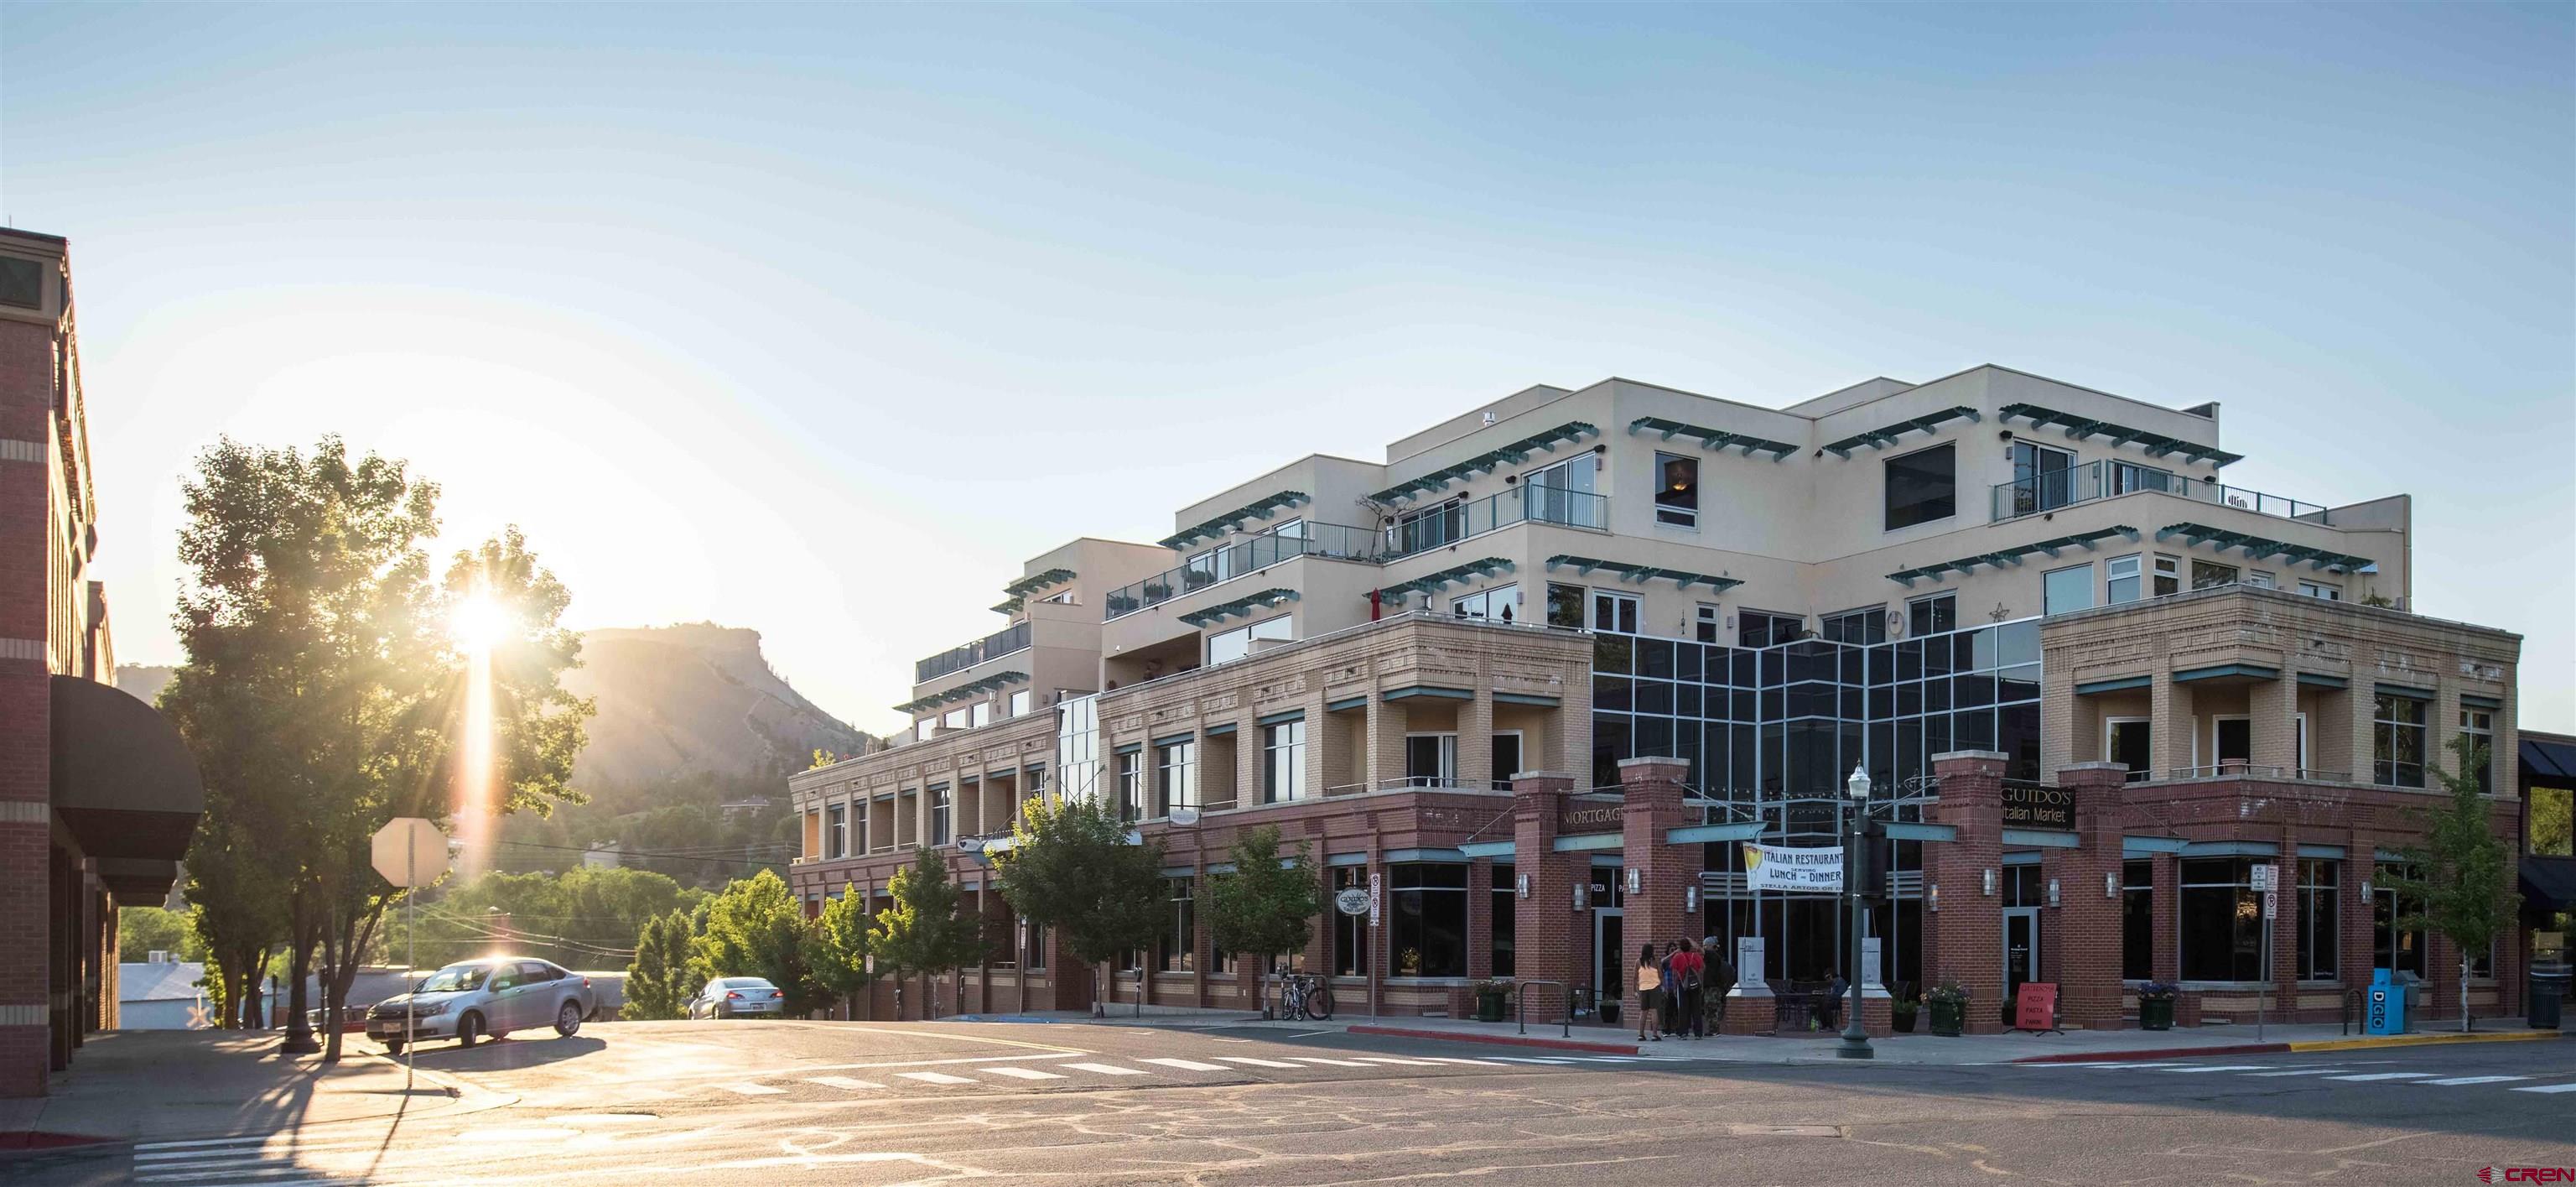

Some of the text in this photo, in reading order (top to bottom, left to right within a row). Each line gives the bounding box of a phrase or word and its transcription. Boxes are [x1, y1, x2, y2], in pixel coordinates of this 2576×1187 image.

[2000, 788, 2071, 805] GUIDO'S
[2002, 806, 2067, 822] Italian Market
[1763, 851, 1844, 866] ITALIAN RESTAURANT
[1769, 868, 1842, 882] LUNCH DINNER
[1591, 883, 1606, 892] PIZZA
